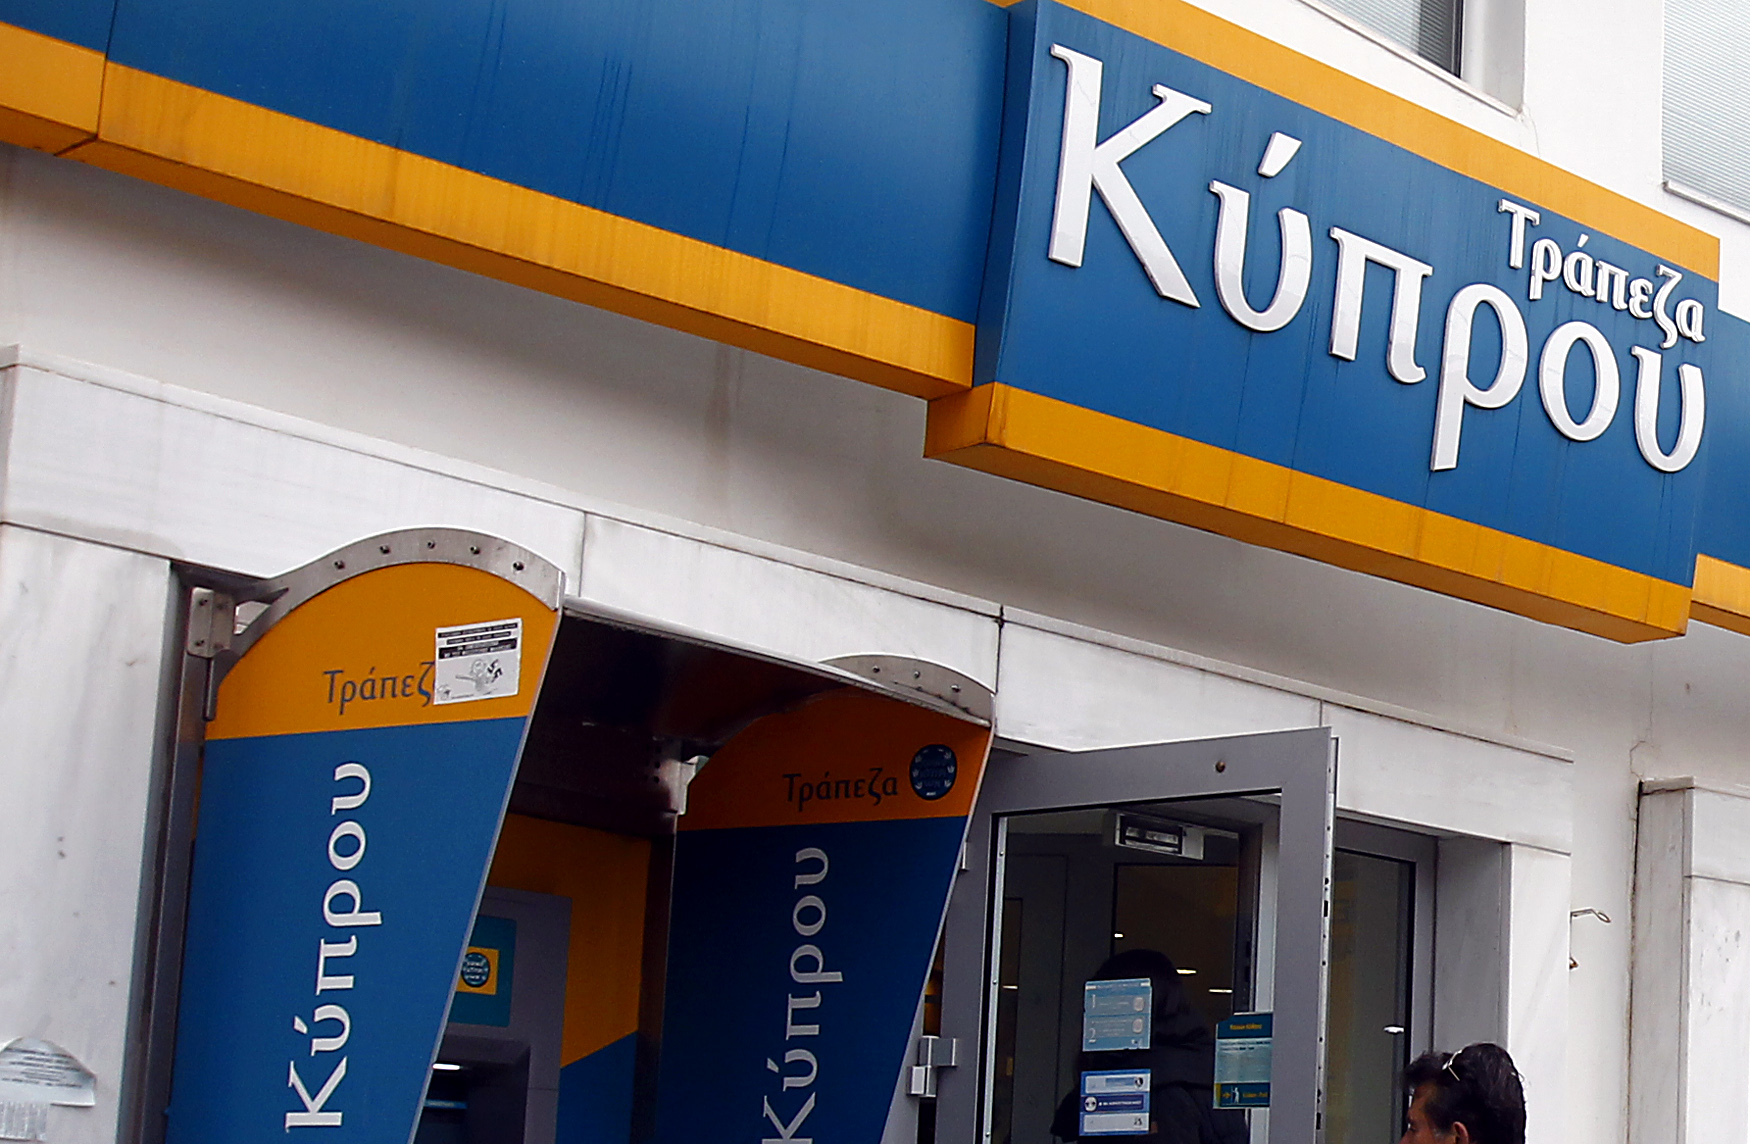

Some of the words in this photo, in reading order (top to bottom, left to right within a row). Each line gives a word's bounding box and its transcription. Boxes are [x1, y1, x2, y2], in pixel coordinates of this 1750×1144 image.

[1048, 42, 1706, 472] Κύπρου
[1498, 198, 1706, 349] Τράπεζα
[323, 661, 437, 716] Τράπεζ
[782, 767, 898, 813] Τράπεζα
[283, 762, 383, 1134] Κύπρου
